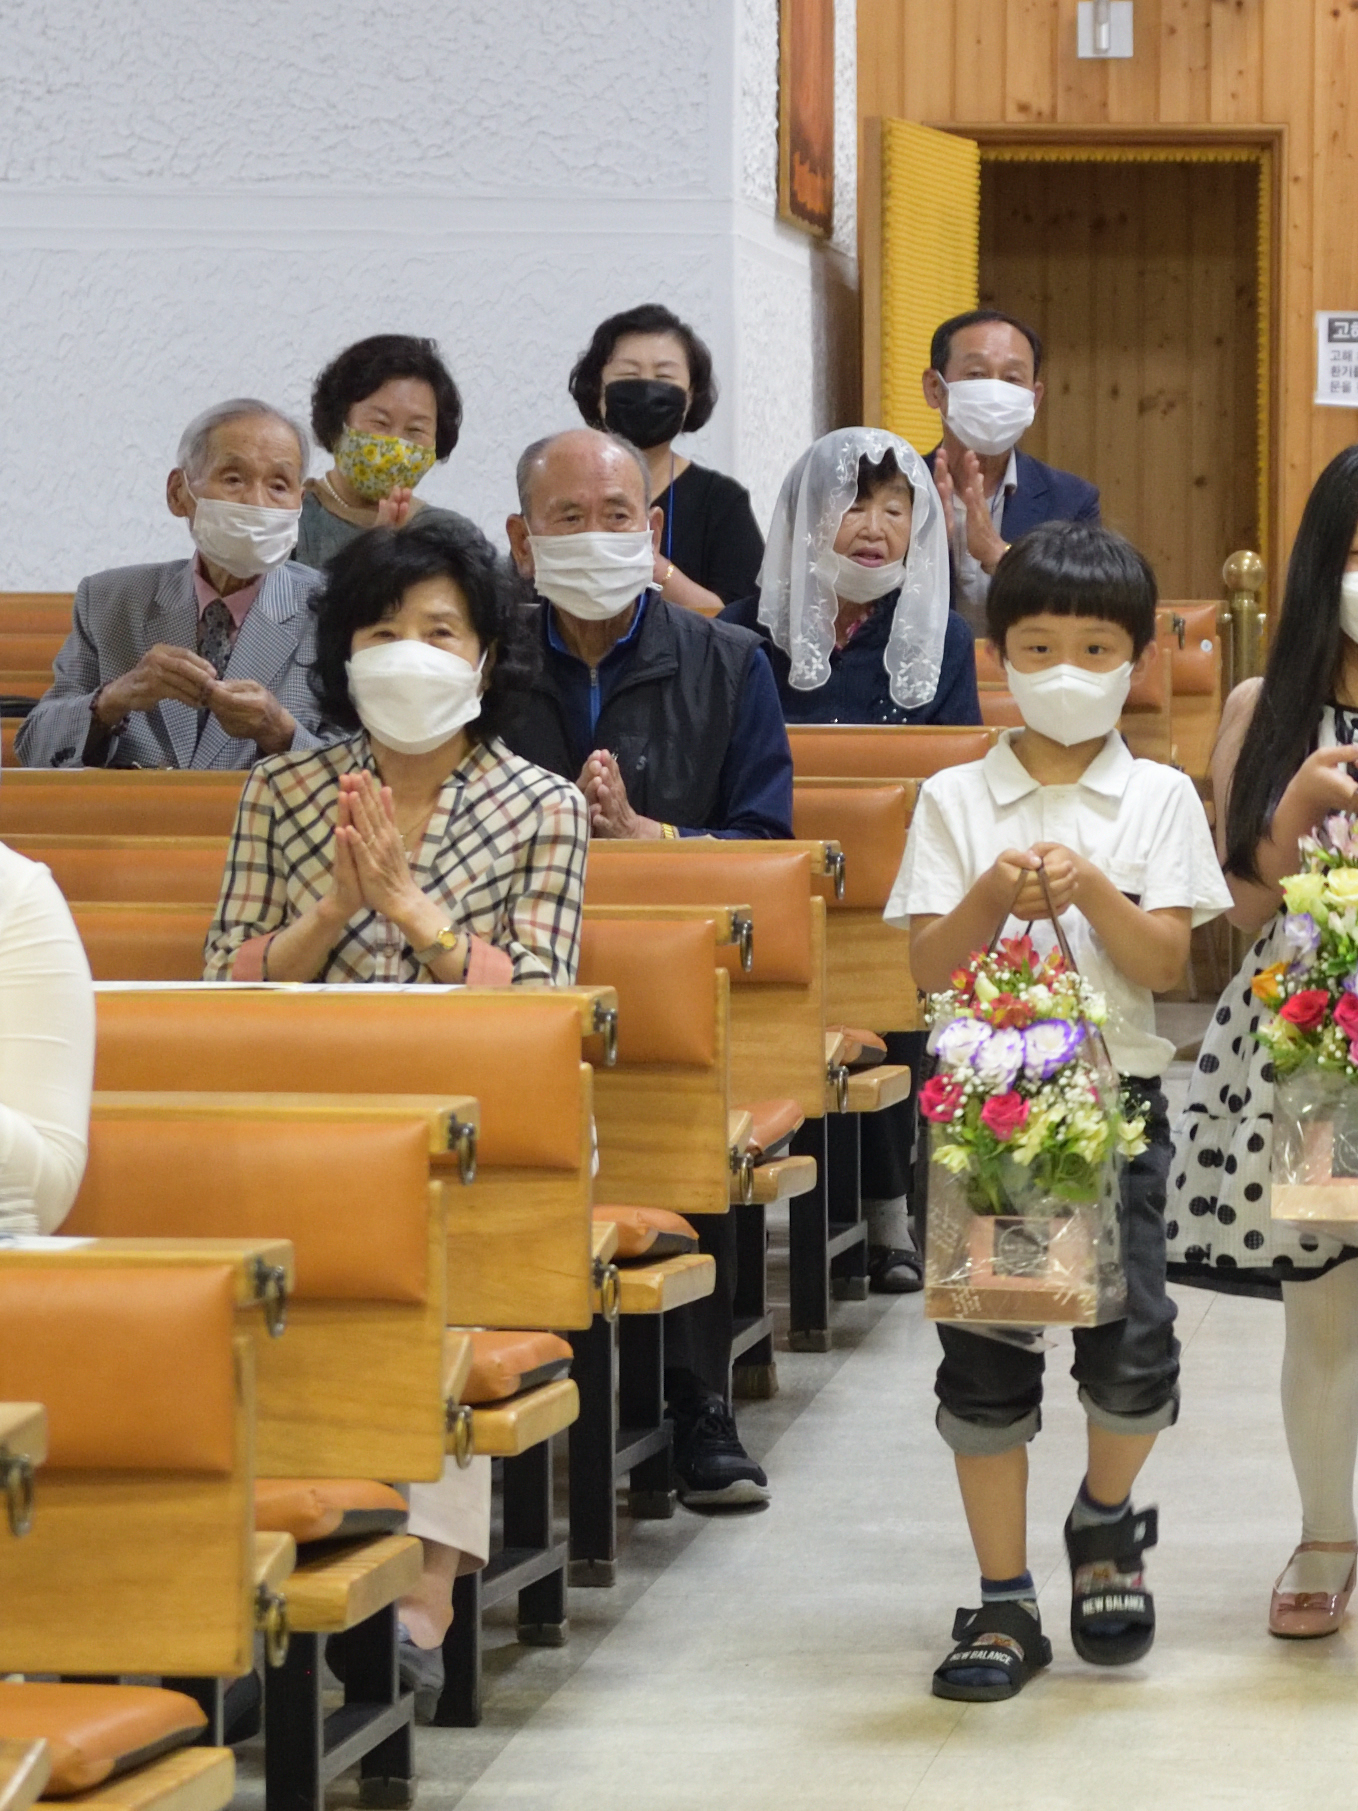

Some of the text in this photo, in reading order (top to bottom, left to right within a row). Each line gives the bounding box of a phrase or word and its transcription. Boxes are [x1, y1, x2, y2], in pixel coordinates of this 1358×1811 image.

[1330, 349, 1353, 362] 고해
[1330, 380, 1352, 393] 문을
[1082, 1596, 1104, 1616] NEW
[970, 1650, 1013, 1666] BALANCE
